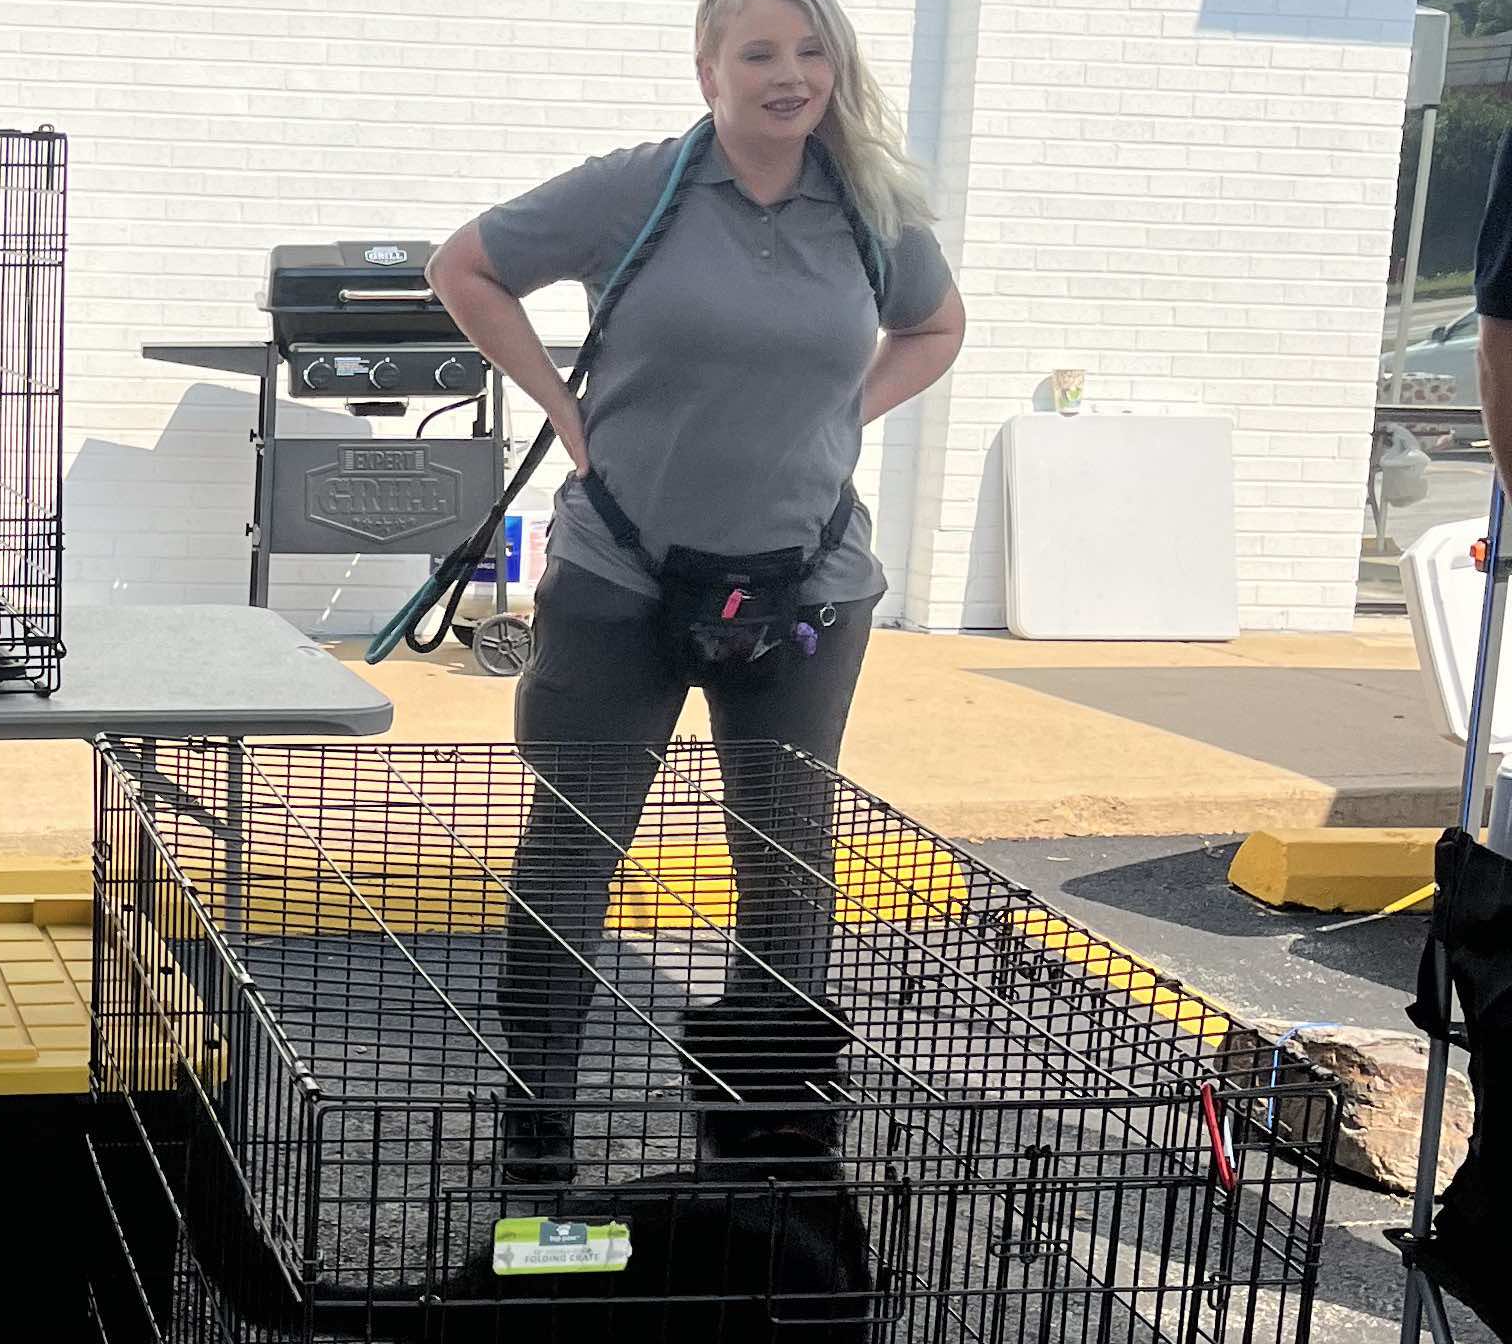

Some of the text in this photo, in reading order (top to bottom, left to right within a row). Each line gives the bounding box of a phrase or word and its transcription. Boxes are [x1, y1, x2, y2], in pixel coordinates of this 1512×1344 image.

[353, 450, 416, 471] EXPERT
[318, 477, 447, 515] GRILL
[525, 1253, 599, 1264] FOLDING CRATE
